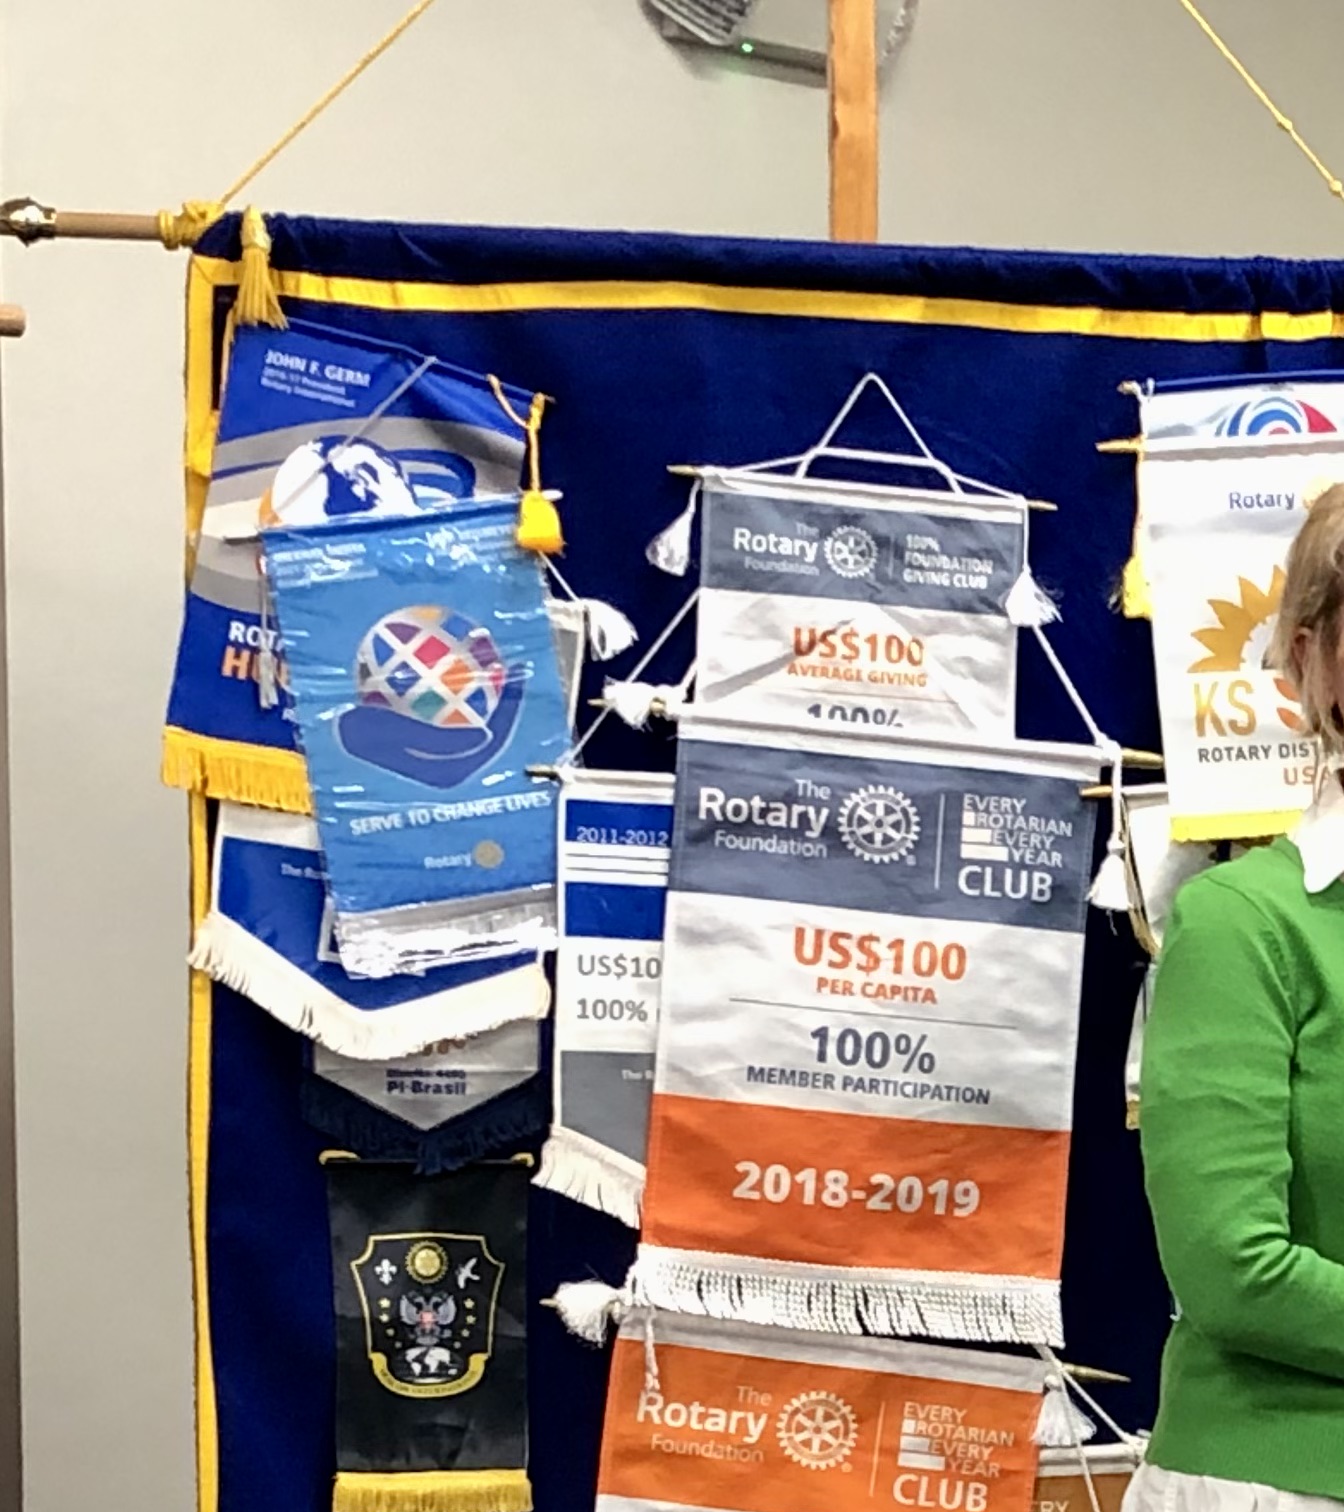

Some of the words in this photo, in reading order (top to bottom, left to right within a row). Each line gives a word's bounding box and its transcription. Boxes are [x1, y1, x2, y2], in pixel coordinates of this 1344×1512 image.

[264, 349, 307, 372] JOHN
[324, 365, 371, 388] GERM
[1229, 492, 1296, 512] Rotary
[733, 527, 818, 562] Rotary
[744, 557, 820, 576] Foundation
[904, 552, 994, 574] FOUNDATION
[903, 570, 950, 587] GIVING
[952, 573, 989, 590] CLUB
[794, 627, 924, 667] US$100
[788, 663, 863, 682] AVERAGE
[867, 671, 928, 688] GIVING
[1193, 680, 1257, 738] KS
[1197, 745, 1272, 763] ROTARY
[795, 779, 831, 799] The
[350, 813, 403, 836] SERVE
[407, 809, 430, 827] TO
[432, 797, 502, 822] CHANGE
[506, 790, 551, 812] LIVES
[698, 787, 829, 838] Rotary
[963, 793, 1027, 814] EVERY
[576, 825, 669, 848] 2011-2012
[977, 812, 1073, 837] ROTARIAN
[714, 830, 828, 859] Foundation
[993, 830, 1056, 850] EVERY
[1010, 847, 1063, 868] YEAR
[958, 865, 1053, 902] CLUB
[794, 926, 967, 981] US$100
[816, 976, 855, 997] PER
[860, 982, 938, 1005] CAPITA
[576, 998, 648, 1023] 100%
[810, 1026, 936, 1074] 100%
[747, 1066, 836, 1091] MEMBER
[841, 1076, 990, 1105] PARTICIPATION
[732, 1160, 980, 1218] 2018-2019
[736, 1385, 773, 1407] The
[636, 1390, 768, 1444] Rotary
[903, 1401, 968, 1424] EVERY
[915, 1420, 1015, 1447] ROTARIAN
[650, 1433, 764, 1463] Foundation
[930, 1440, 994, 1461] EVERY
[948, 1458, 1000, 1478] YEAR
[892, 1473, 988, 1512] CLUB
